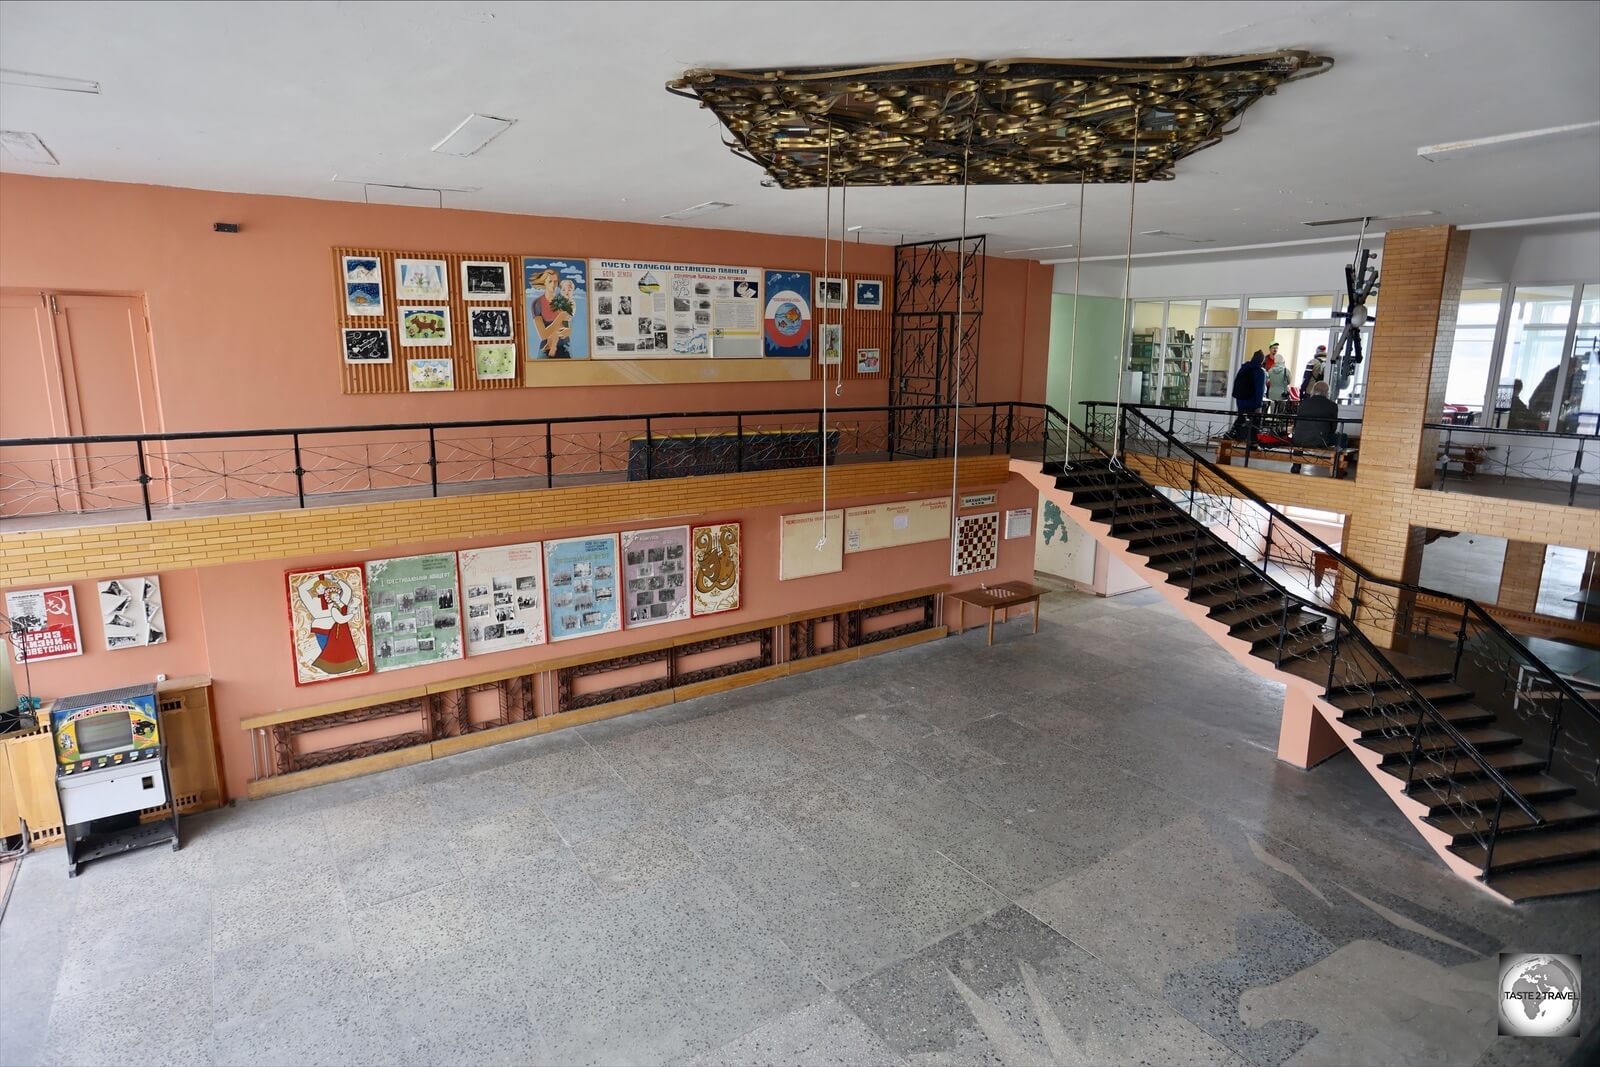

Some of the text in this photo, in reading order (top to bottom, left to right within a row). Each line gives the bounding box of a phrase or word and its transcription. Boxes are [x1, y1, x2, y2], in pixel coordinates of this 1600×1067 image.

[601, 261, 631, 269] ПУСТЬ
[633, 263, 671, 271] ГОЛУБОЙ
[673, 265, 716, 273] ОСТАНЕТСЯ
[20, 643, 77, 657] ОВЕТСКИЙ!
